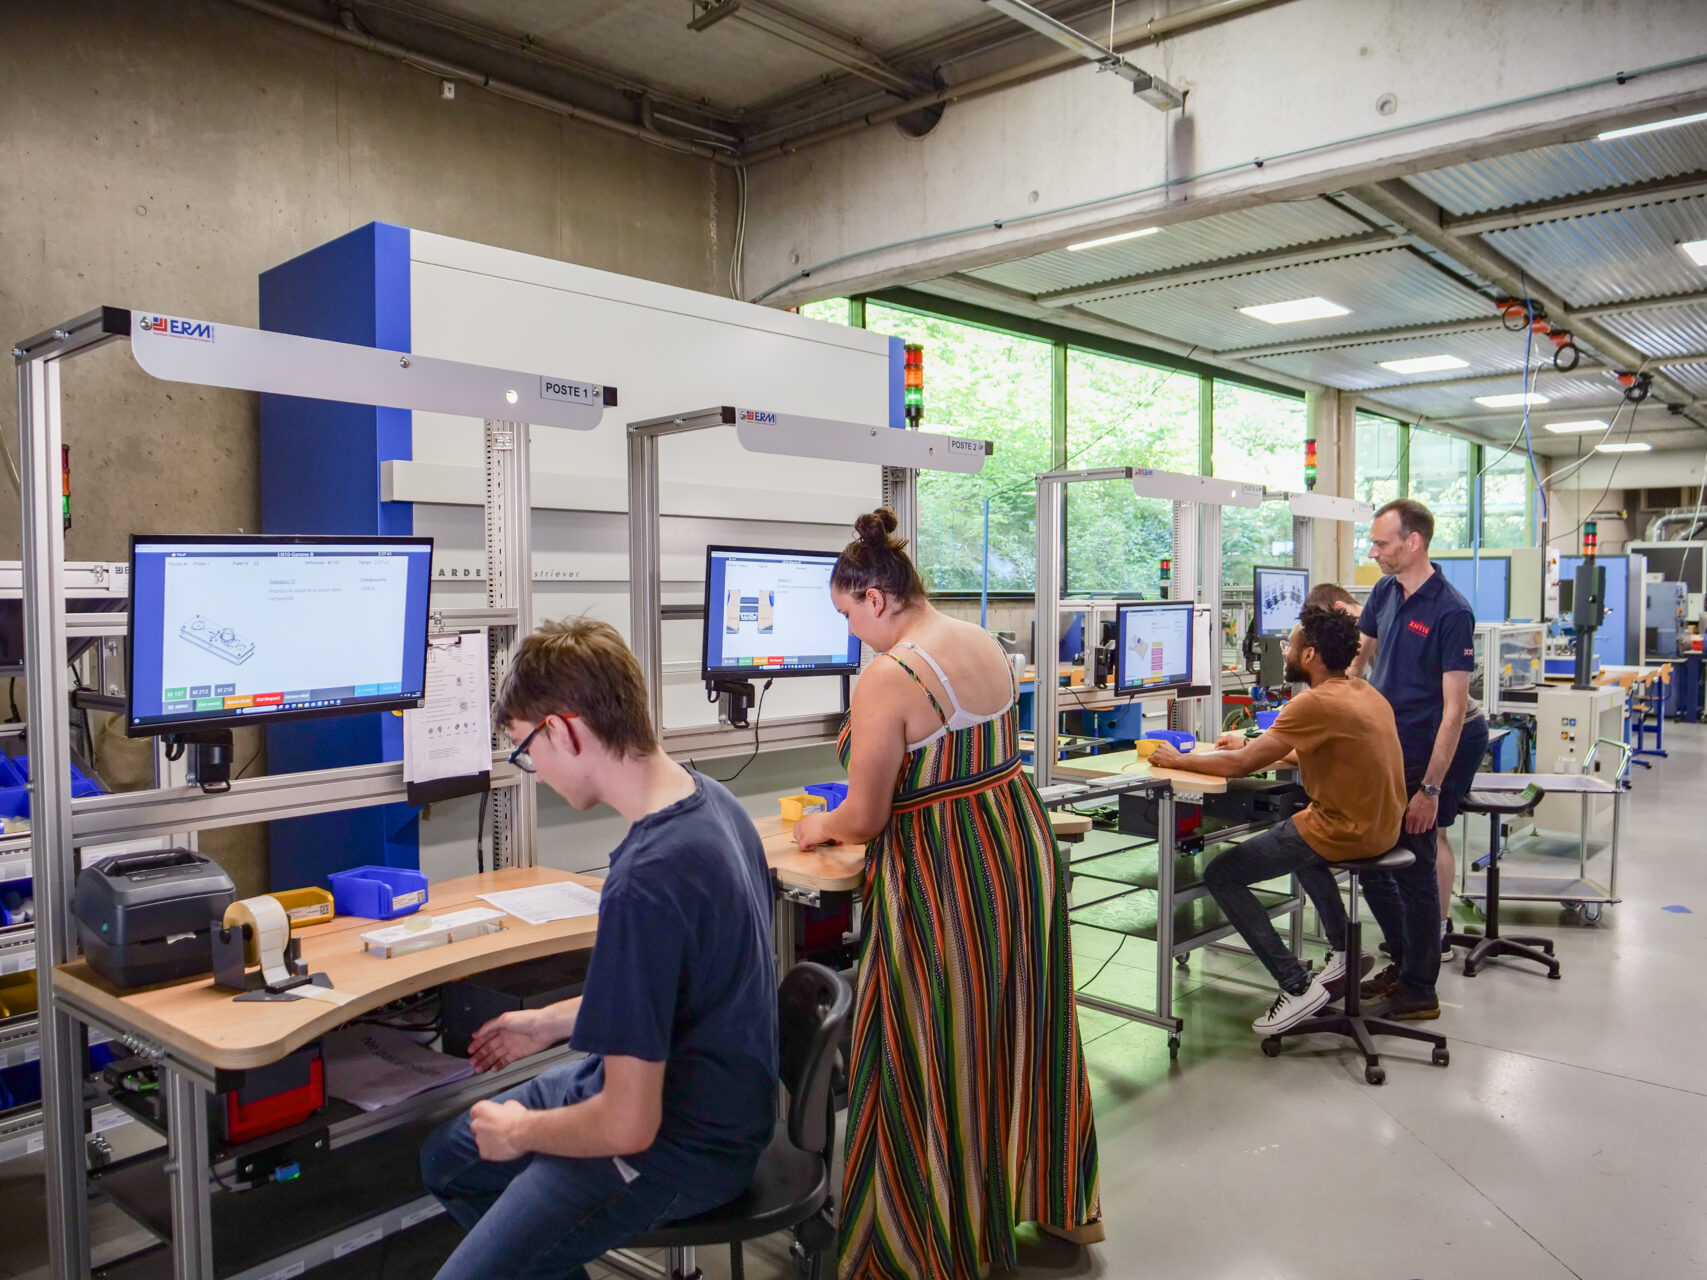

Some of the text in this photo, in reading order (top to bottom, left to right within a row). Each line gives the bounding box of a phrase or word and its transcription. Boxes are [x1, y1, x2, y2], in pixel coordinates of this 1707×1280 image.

[170, 320, 210, 338] ERM
[546, 382, 588, 398] POSTE 1
[755, 411, 775, 423] ERM
[951, 440, 972, 450] POSTE
[438, 568, 580, 578] ARDE striever
